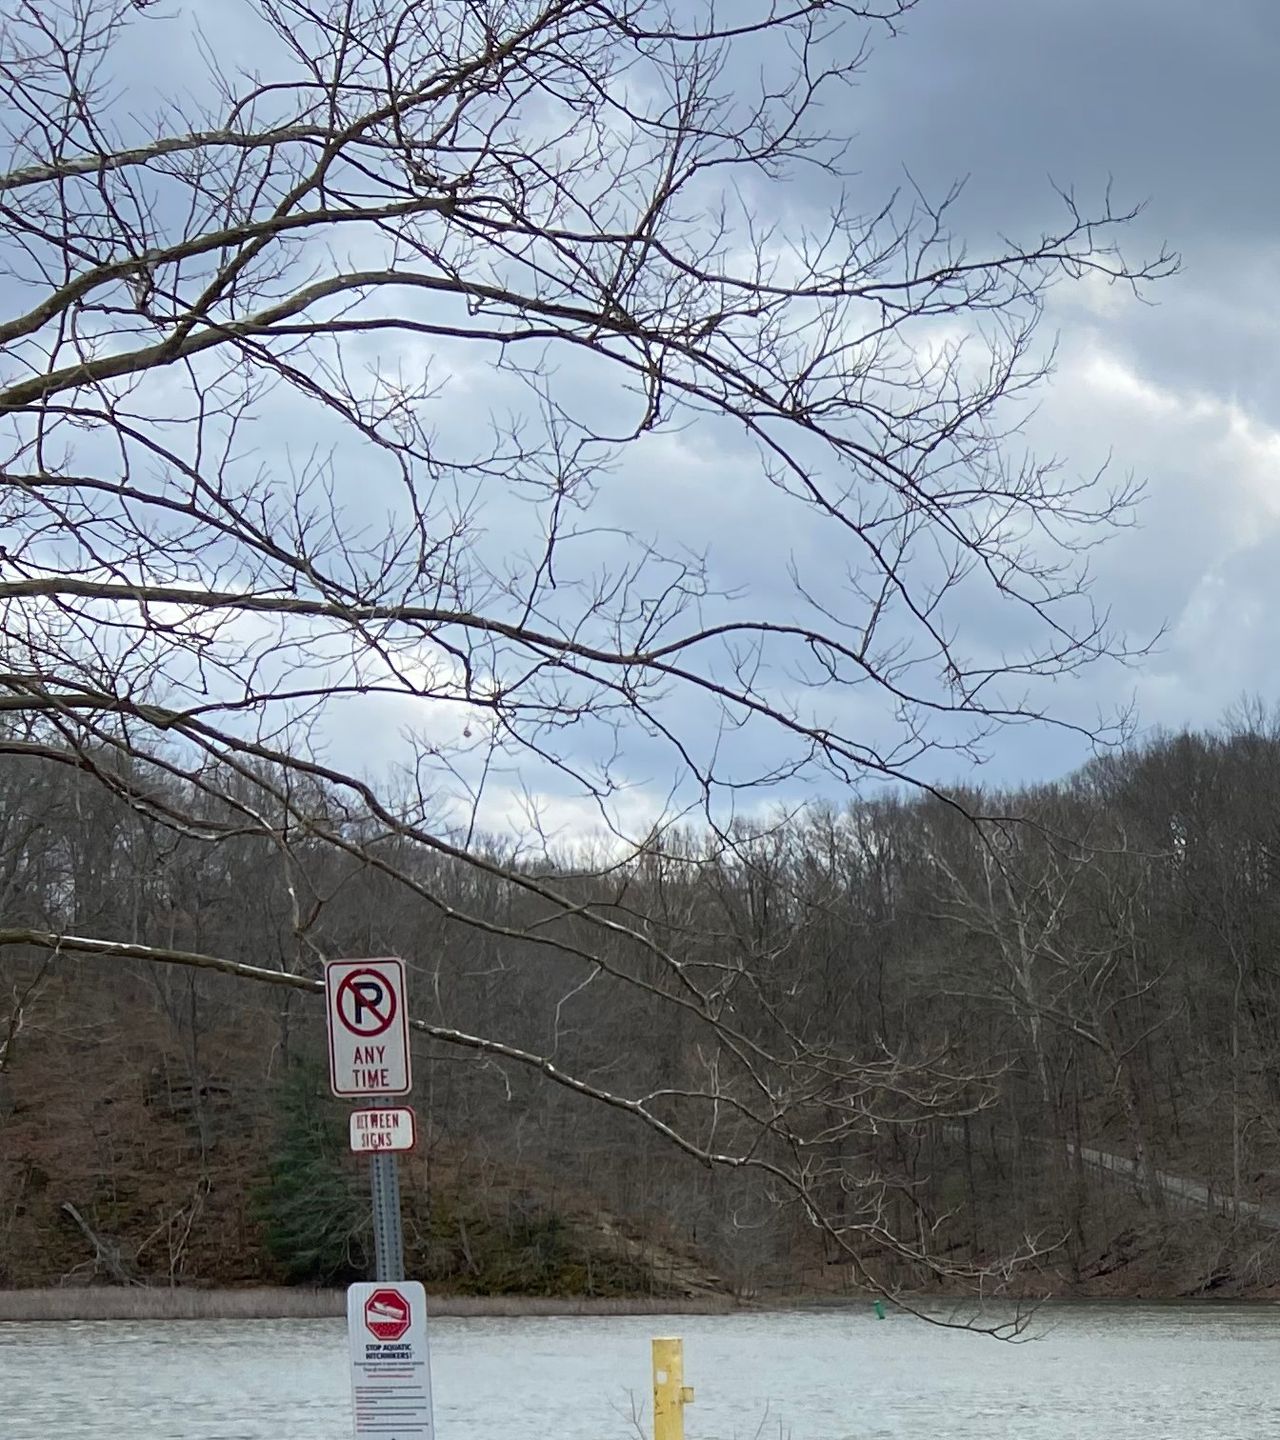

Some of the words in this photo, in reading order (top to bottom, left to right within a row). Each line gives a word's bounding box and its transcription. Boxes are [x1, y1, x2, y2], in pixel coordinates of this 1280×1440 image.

[354, 1046, 385, 1064] ANY
[353, 1069, 389, 1088] TIME
[356, 1113, 399, 1129] BETWEEN
[361, 1133, 392, 1148] SIGNS
